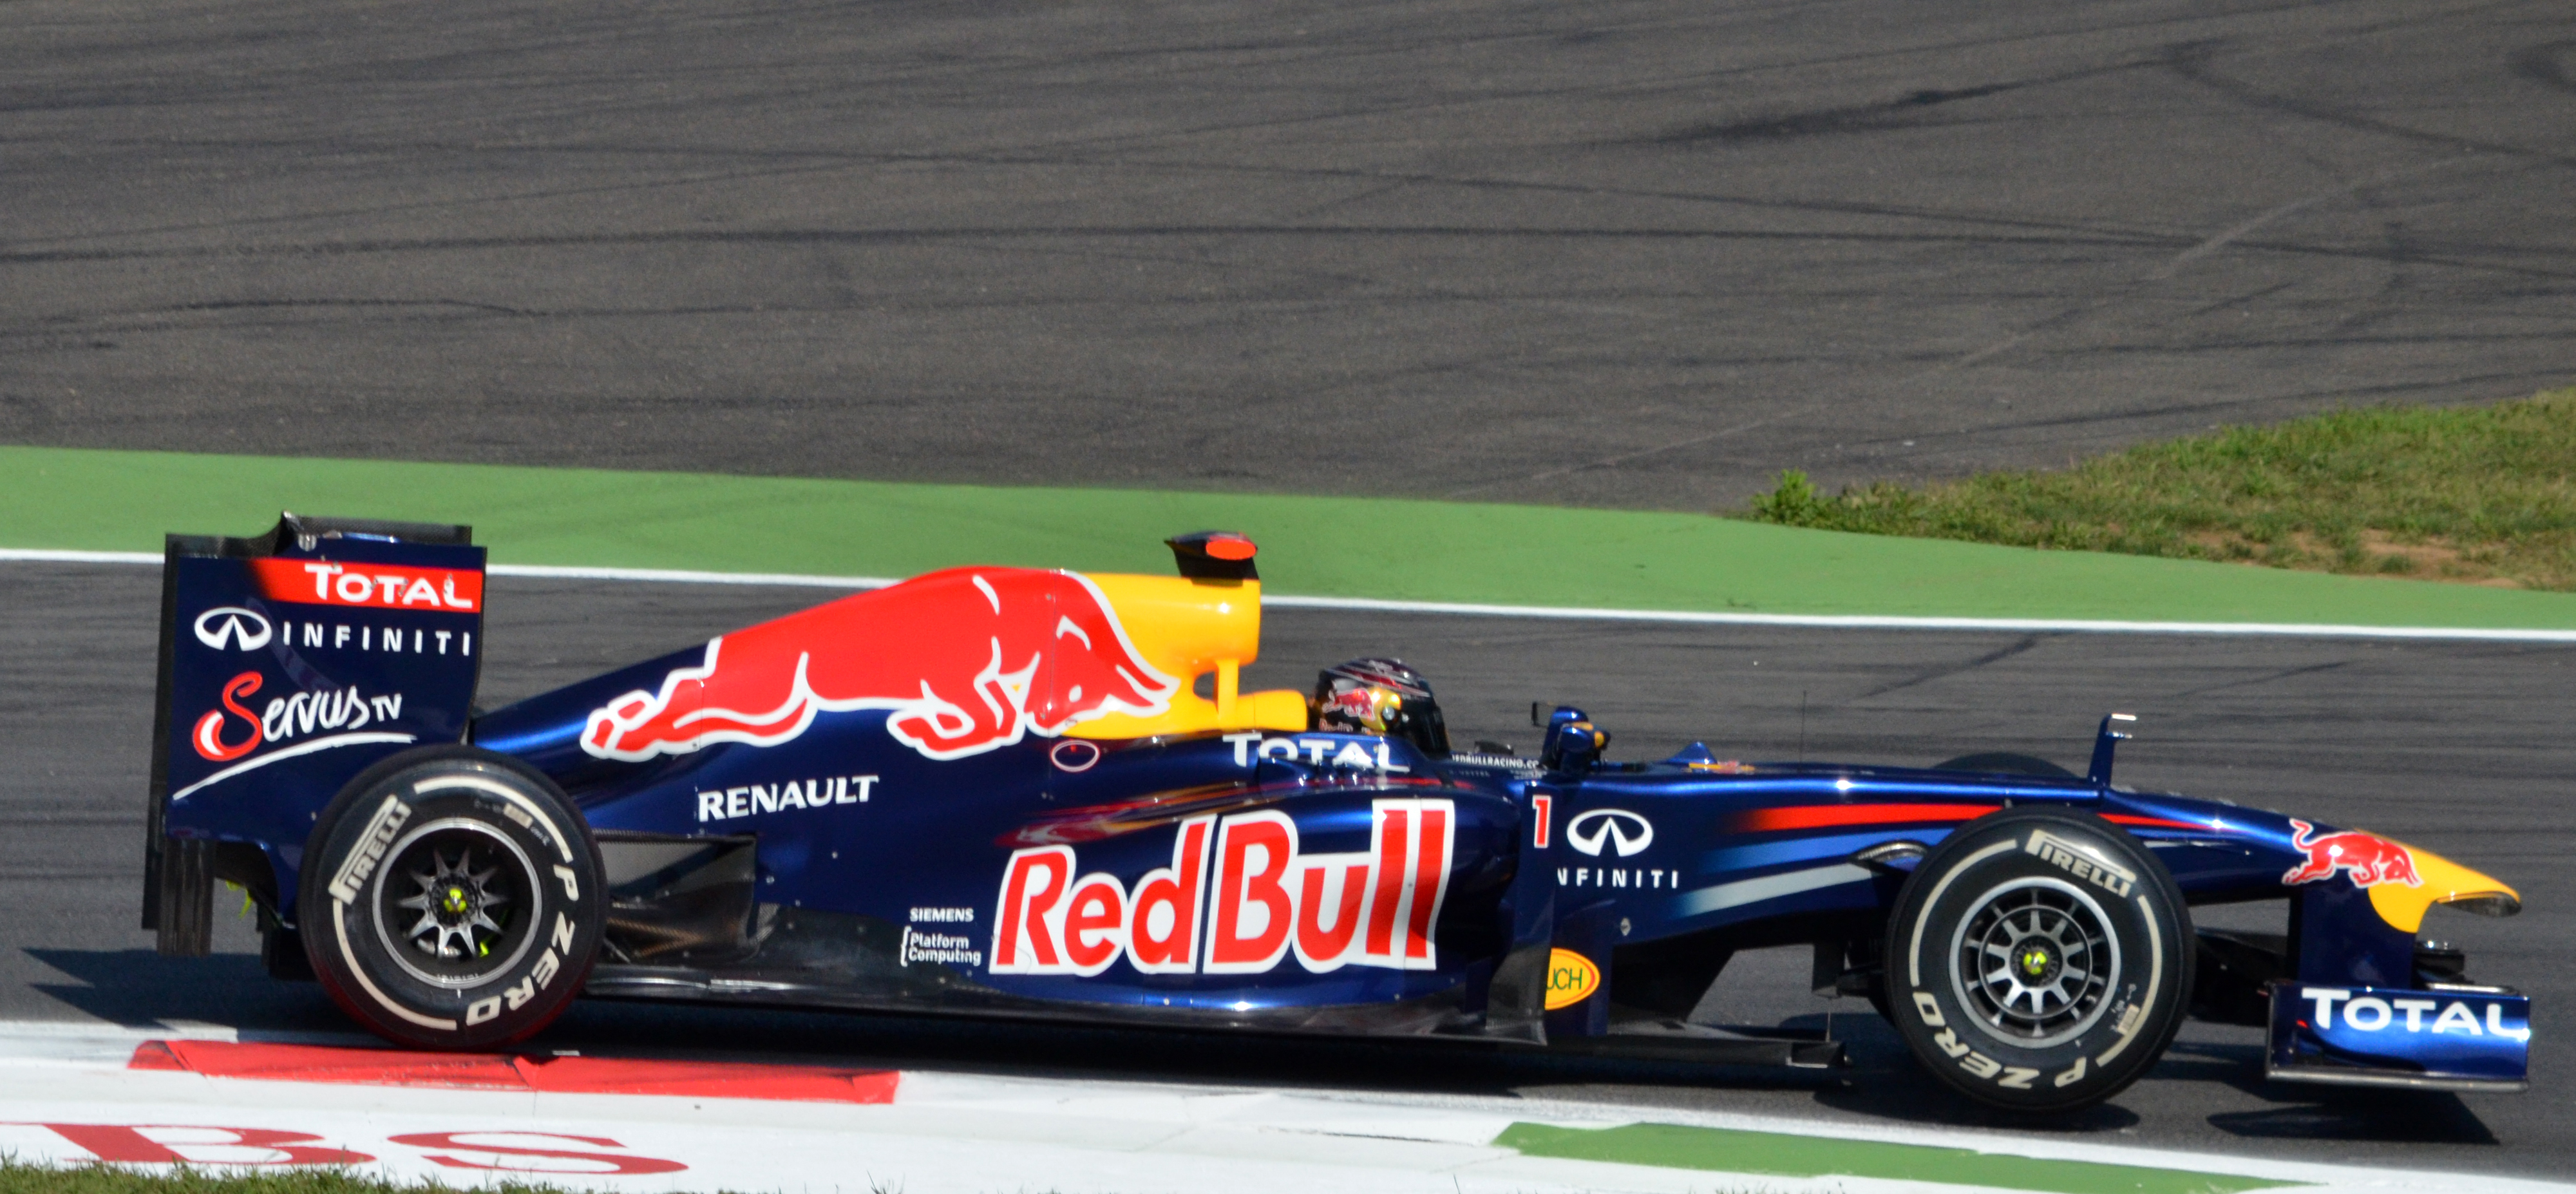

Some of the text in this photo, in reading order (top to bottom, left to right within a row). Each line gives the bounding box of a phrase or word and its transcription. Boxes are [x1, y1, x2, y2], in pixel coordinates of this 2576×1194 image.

[305, 562, 473, 609] TOTAL
[283, 621, 470, 656] INFINITI
[1222, 733, 1410, 772] TOTAL
[698, 775, 879, 822] RENAULT
[1532, 795, 1551, 848] 1
[328, 794, 412, 905] PIRELLI
[2025, 829, 2137, 898] PIRELLI
[989, 799, 1455, 977] Red Bull
[1557, 867, 1679, 889] NFINITI
[909, 907, 974, 922] SIEMENS
[466, 864, 579, 1026] P ZERO
[908, 948, 981, 967] Computing
[910, 932, 970, 949] Platform
[1547, 967, 1583, 990] UCH
[2301, 987, 2531, 1041] TOTAL
[1911, 992, 2041, 1090] ZERO
[2055, 1057, 2087, 1088] P
